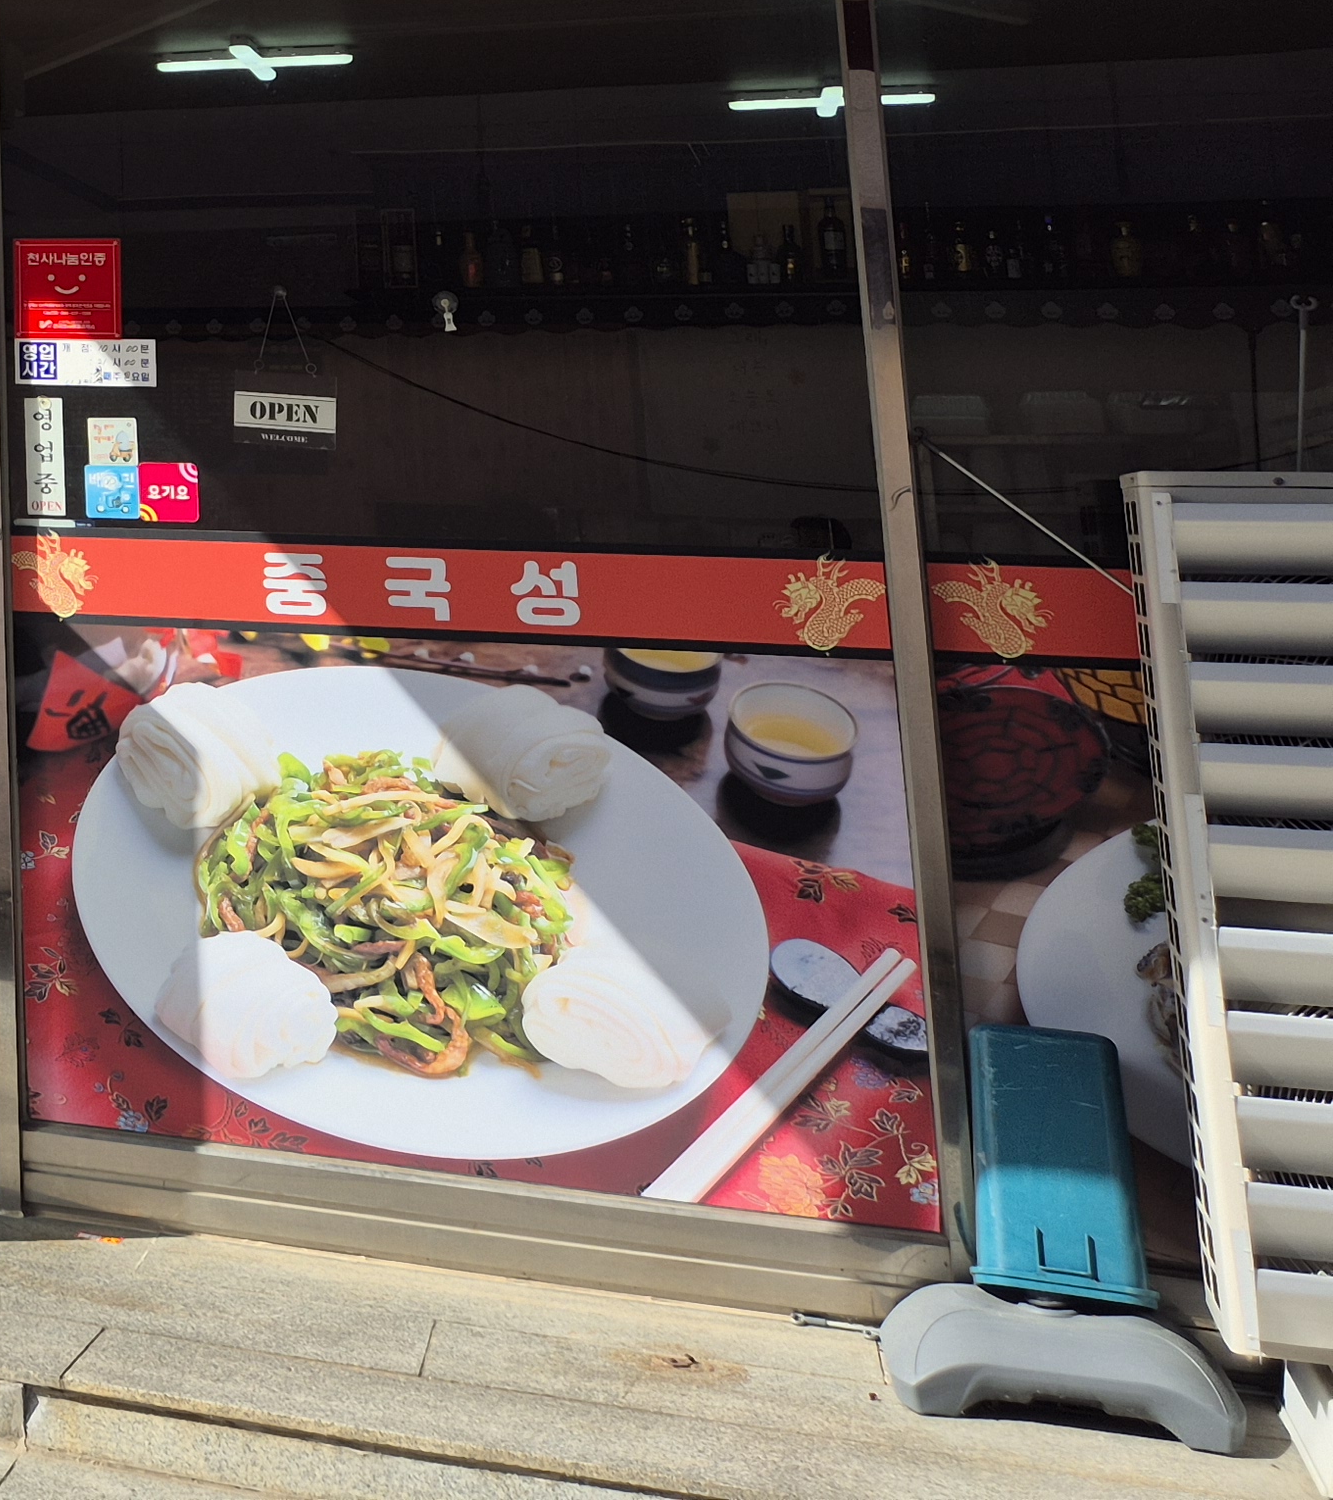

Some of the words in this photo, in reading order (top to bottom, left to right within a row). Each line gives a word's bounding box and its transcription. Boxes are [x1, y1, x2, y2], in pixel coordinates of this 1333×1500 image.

[26, 252, 106, 267] 천사나눔인증
[22, 343, 55, 361] 영업
[22, 360, 56, 378] 시간
[250, 400, 320, 424] OPEN
[260, 432, 308, 443] WELCOME
[147, 484, 191, 500] 요기요
[31, 500, 63, 512] OPEN
[262, 552, 581, 626] 중국성
